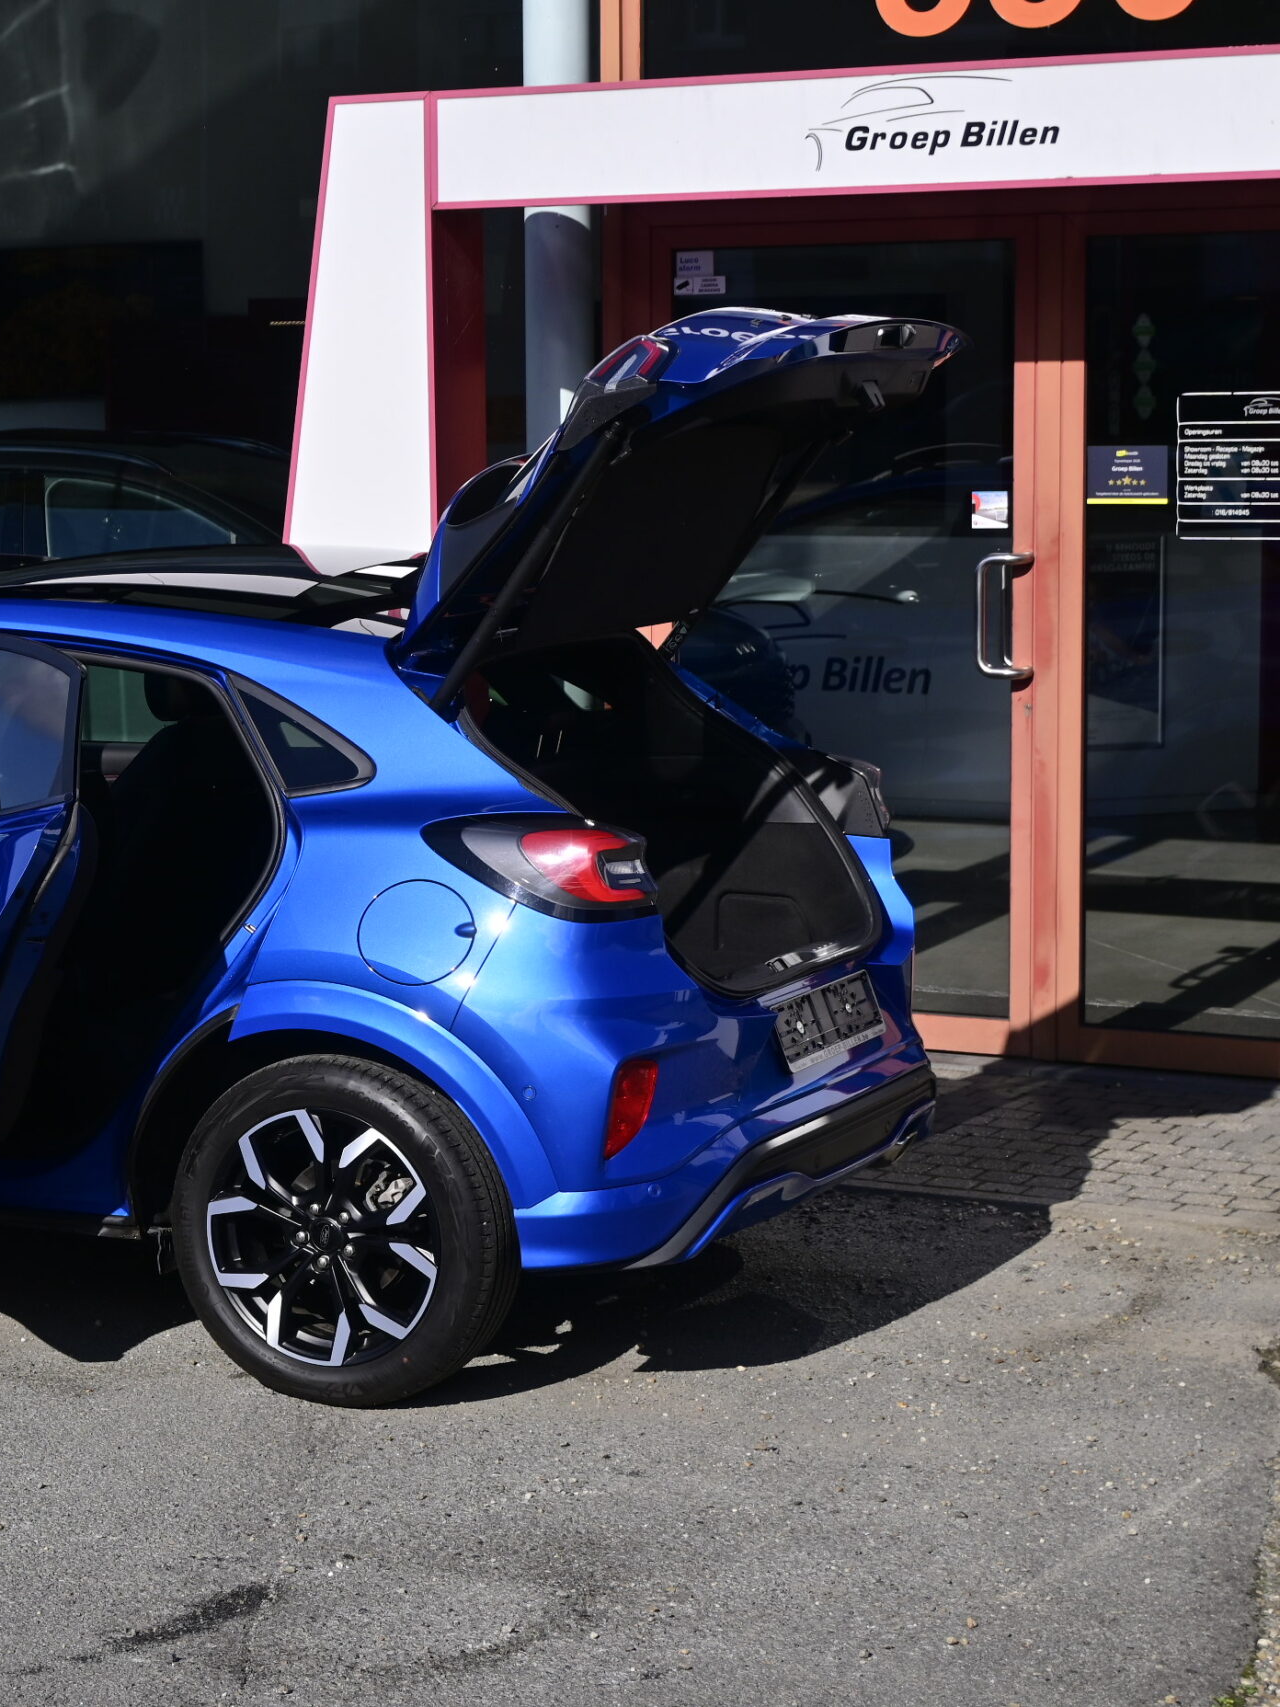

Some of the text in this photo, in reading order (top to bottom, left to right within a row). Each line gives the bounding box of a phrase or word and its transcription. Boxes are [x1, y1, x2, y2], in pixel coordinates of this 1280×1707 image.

[845, 119, 1060, 156] Groep Billen
[821, 655, 932, 695] Billen
